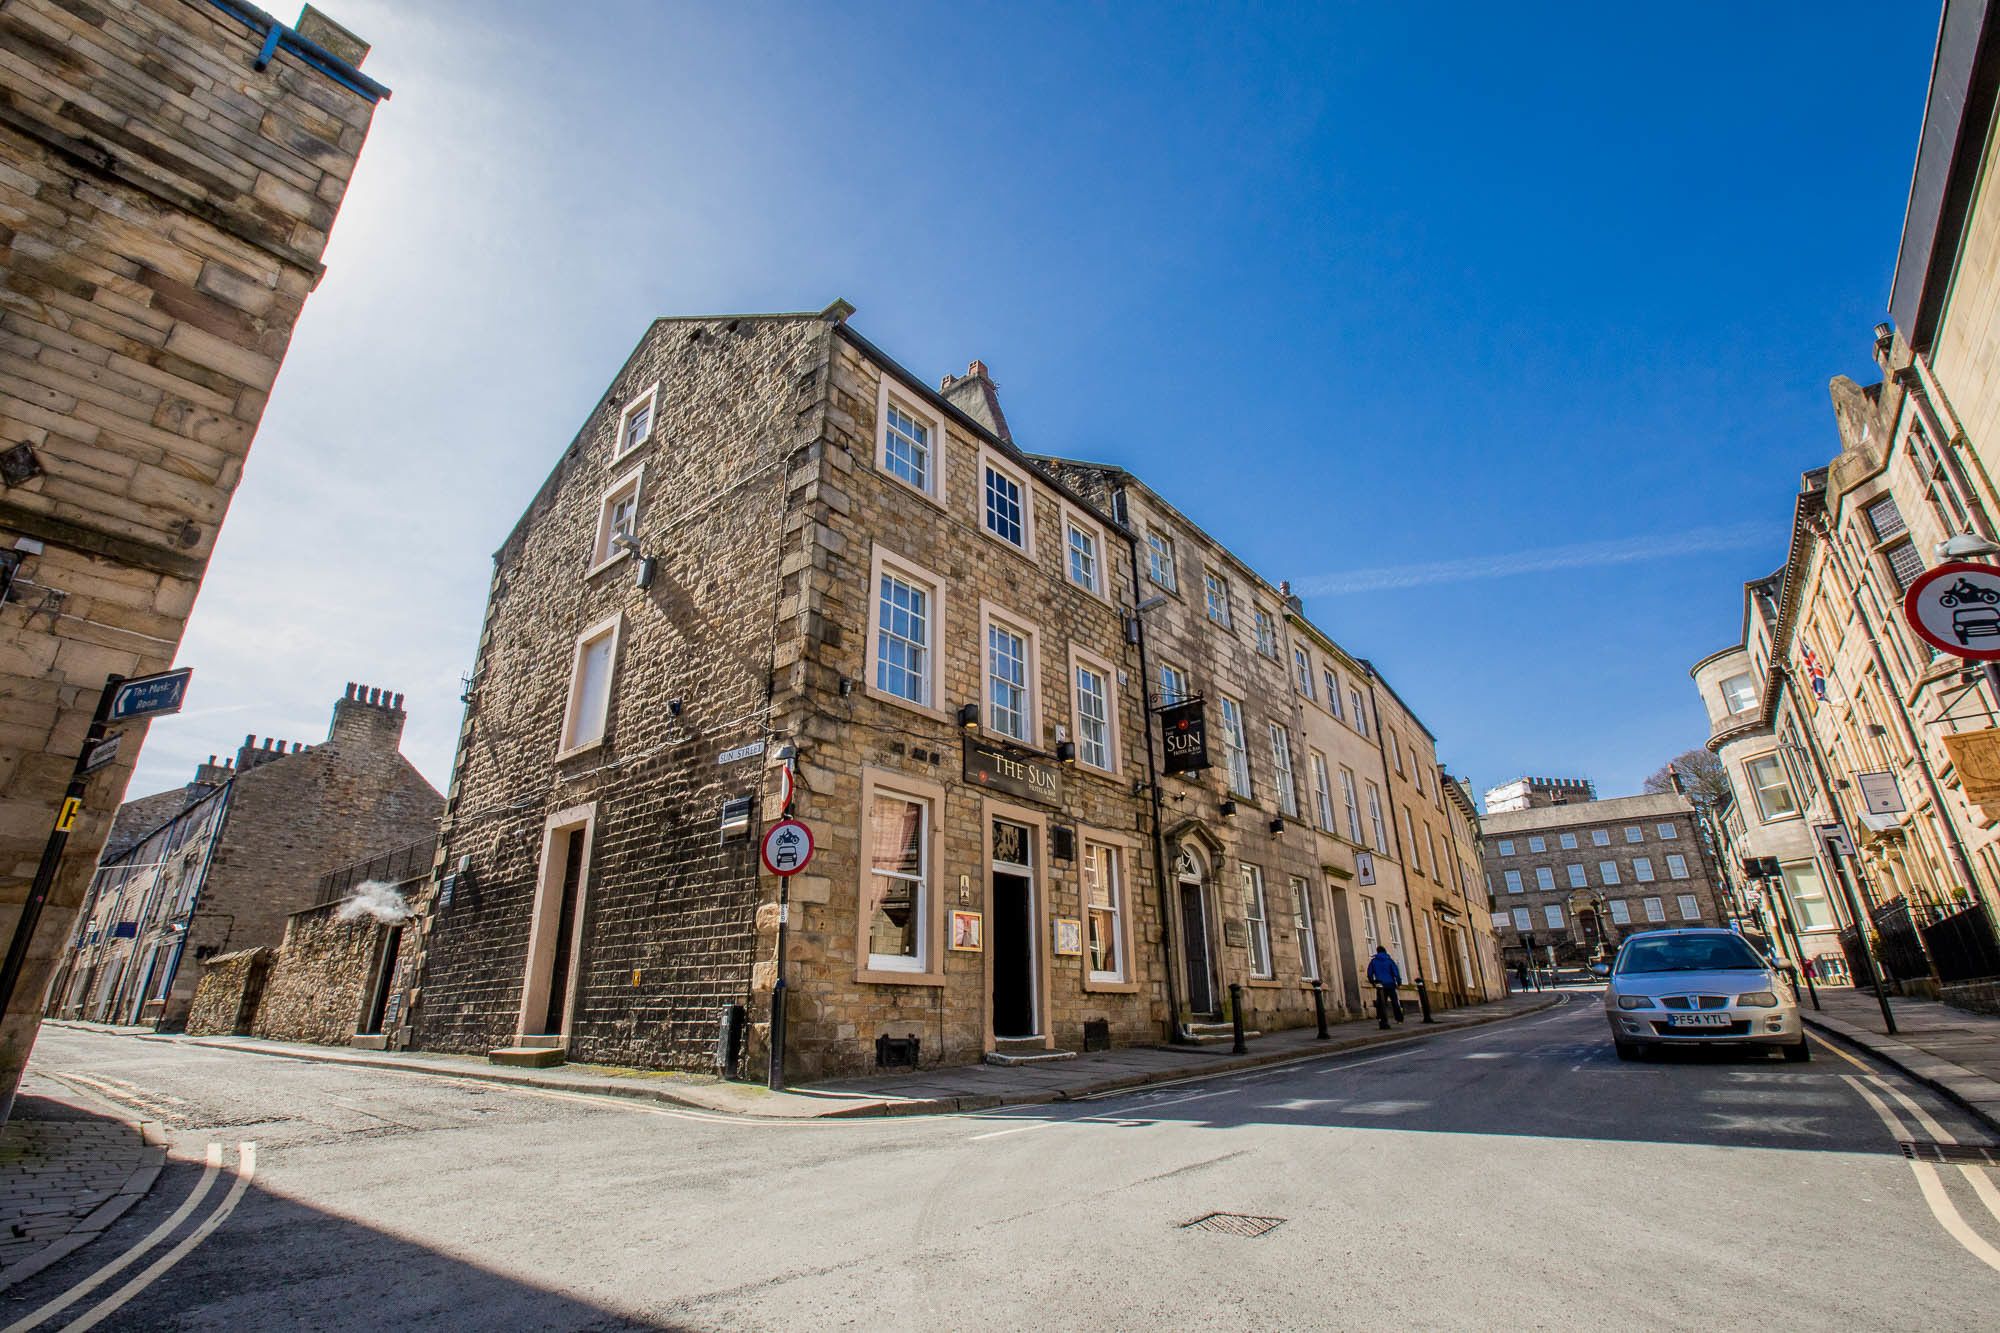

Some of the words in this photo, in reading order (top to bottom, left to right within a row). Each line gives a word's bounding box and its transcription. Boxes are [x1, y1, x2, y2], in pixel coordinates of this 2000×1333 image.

[1167, 731, 1201, 752] SUN
[720, 752, 734, 762] SUN
[737, 744, 761, 759] STREET
[993, 752, 1024, 780] THE
[1028, 764, 1056, 791] SUN
[1672, 1014, 1702, 1025] PF54
[1703, 1013, 1727, 1025] YTL
